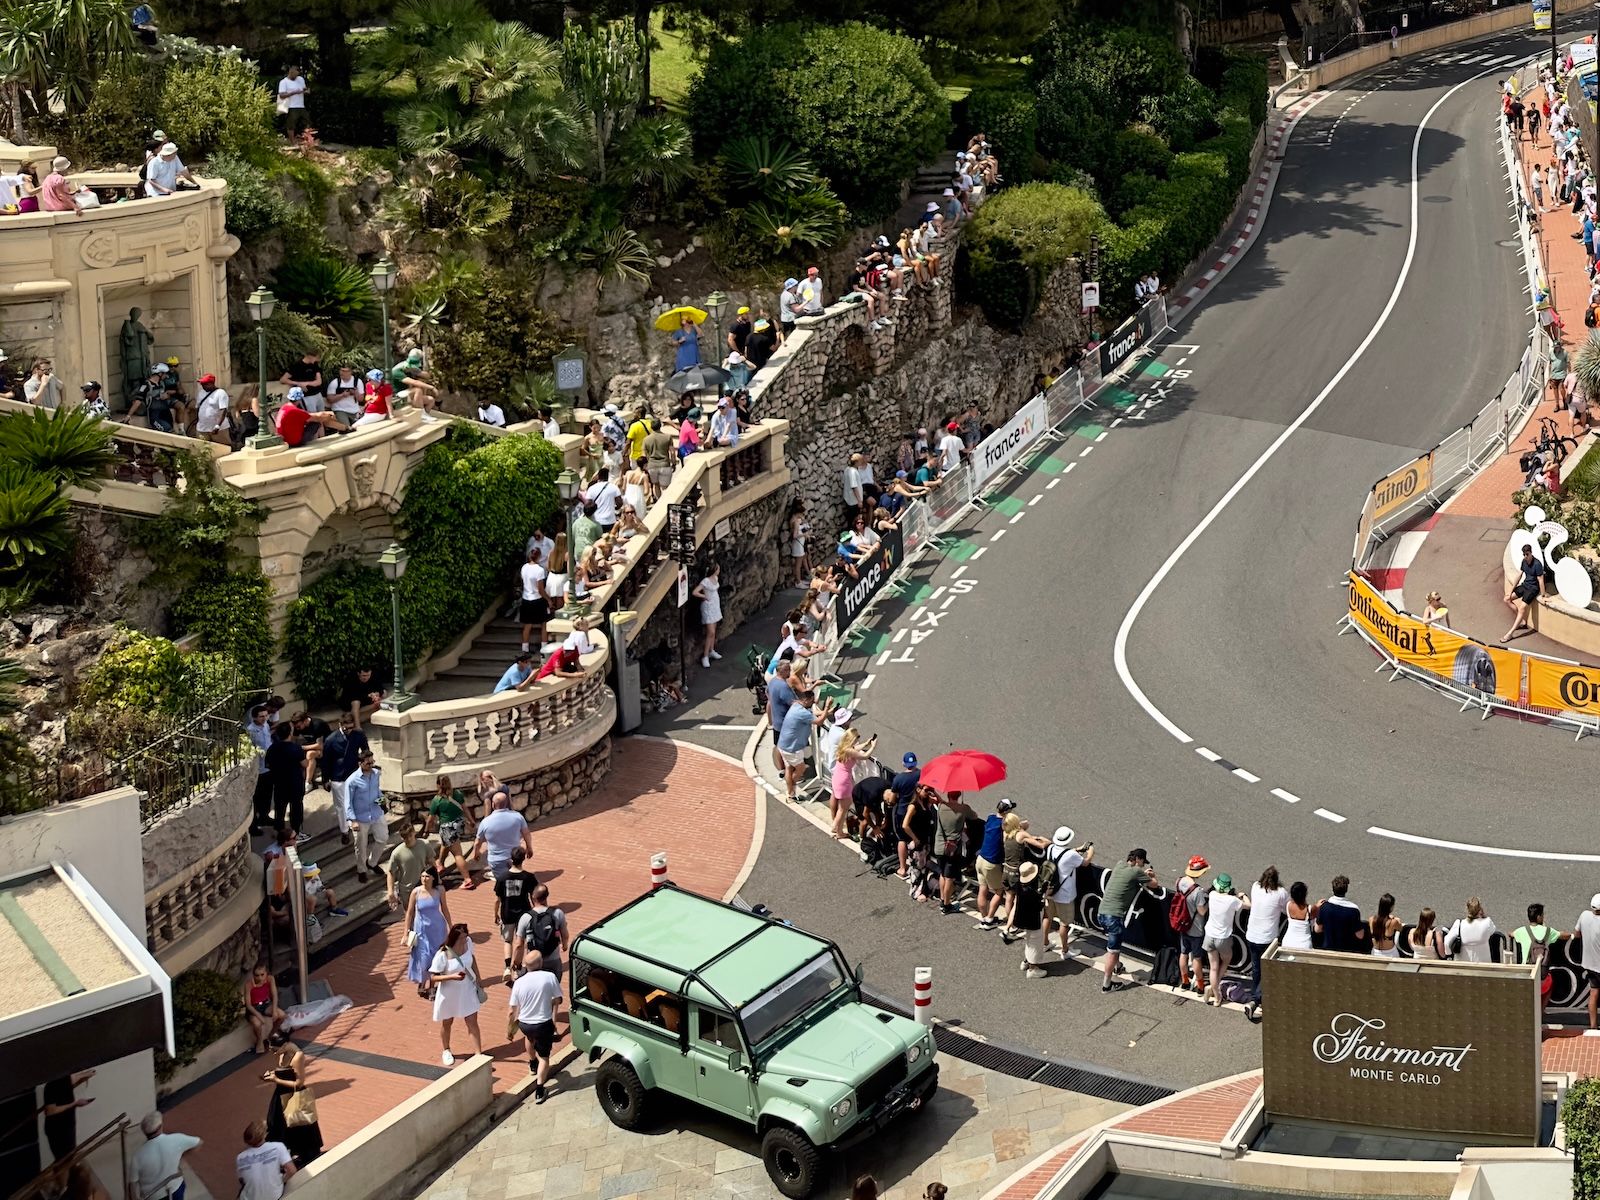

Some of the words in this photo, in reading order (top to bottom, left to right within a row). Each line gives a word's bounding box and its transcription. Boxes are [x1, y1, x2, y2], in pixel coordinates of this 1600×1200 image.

[1127, 369, 1193, 419] TAXIS
[890, 579, 979, 662] TAXIS
[1312, 1013, 1478, 1072] Fairmont
[1350, 1067, 1394, 1082] MONTE
[1400, 1072, 1442, 1085] CARLO
